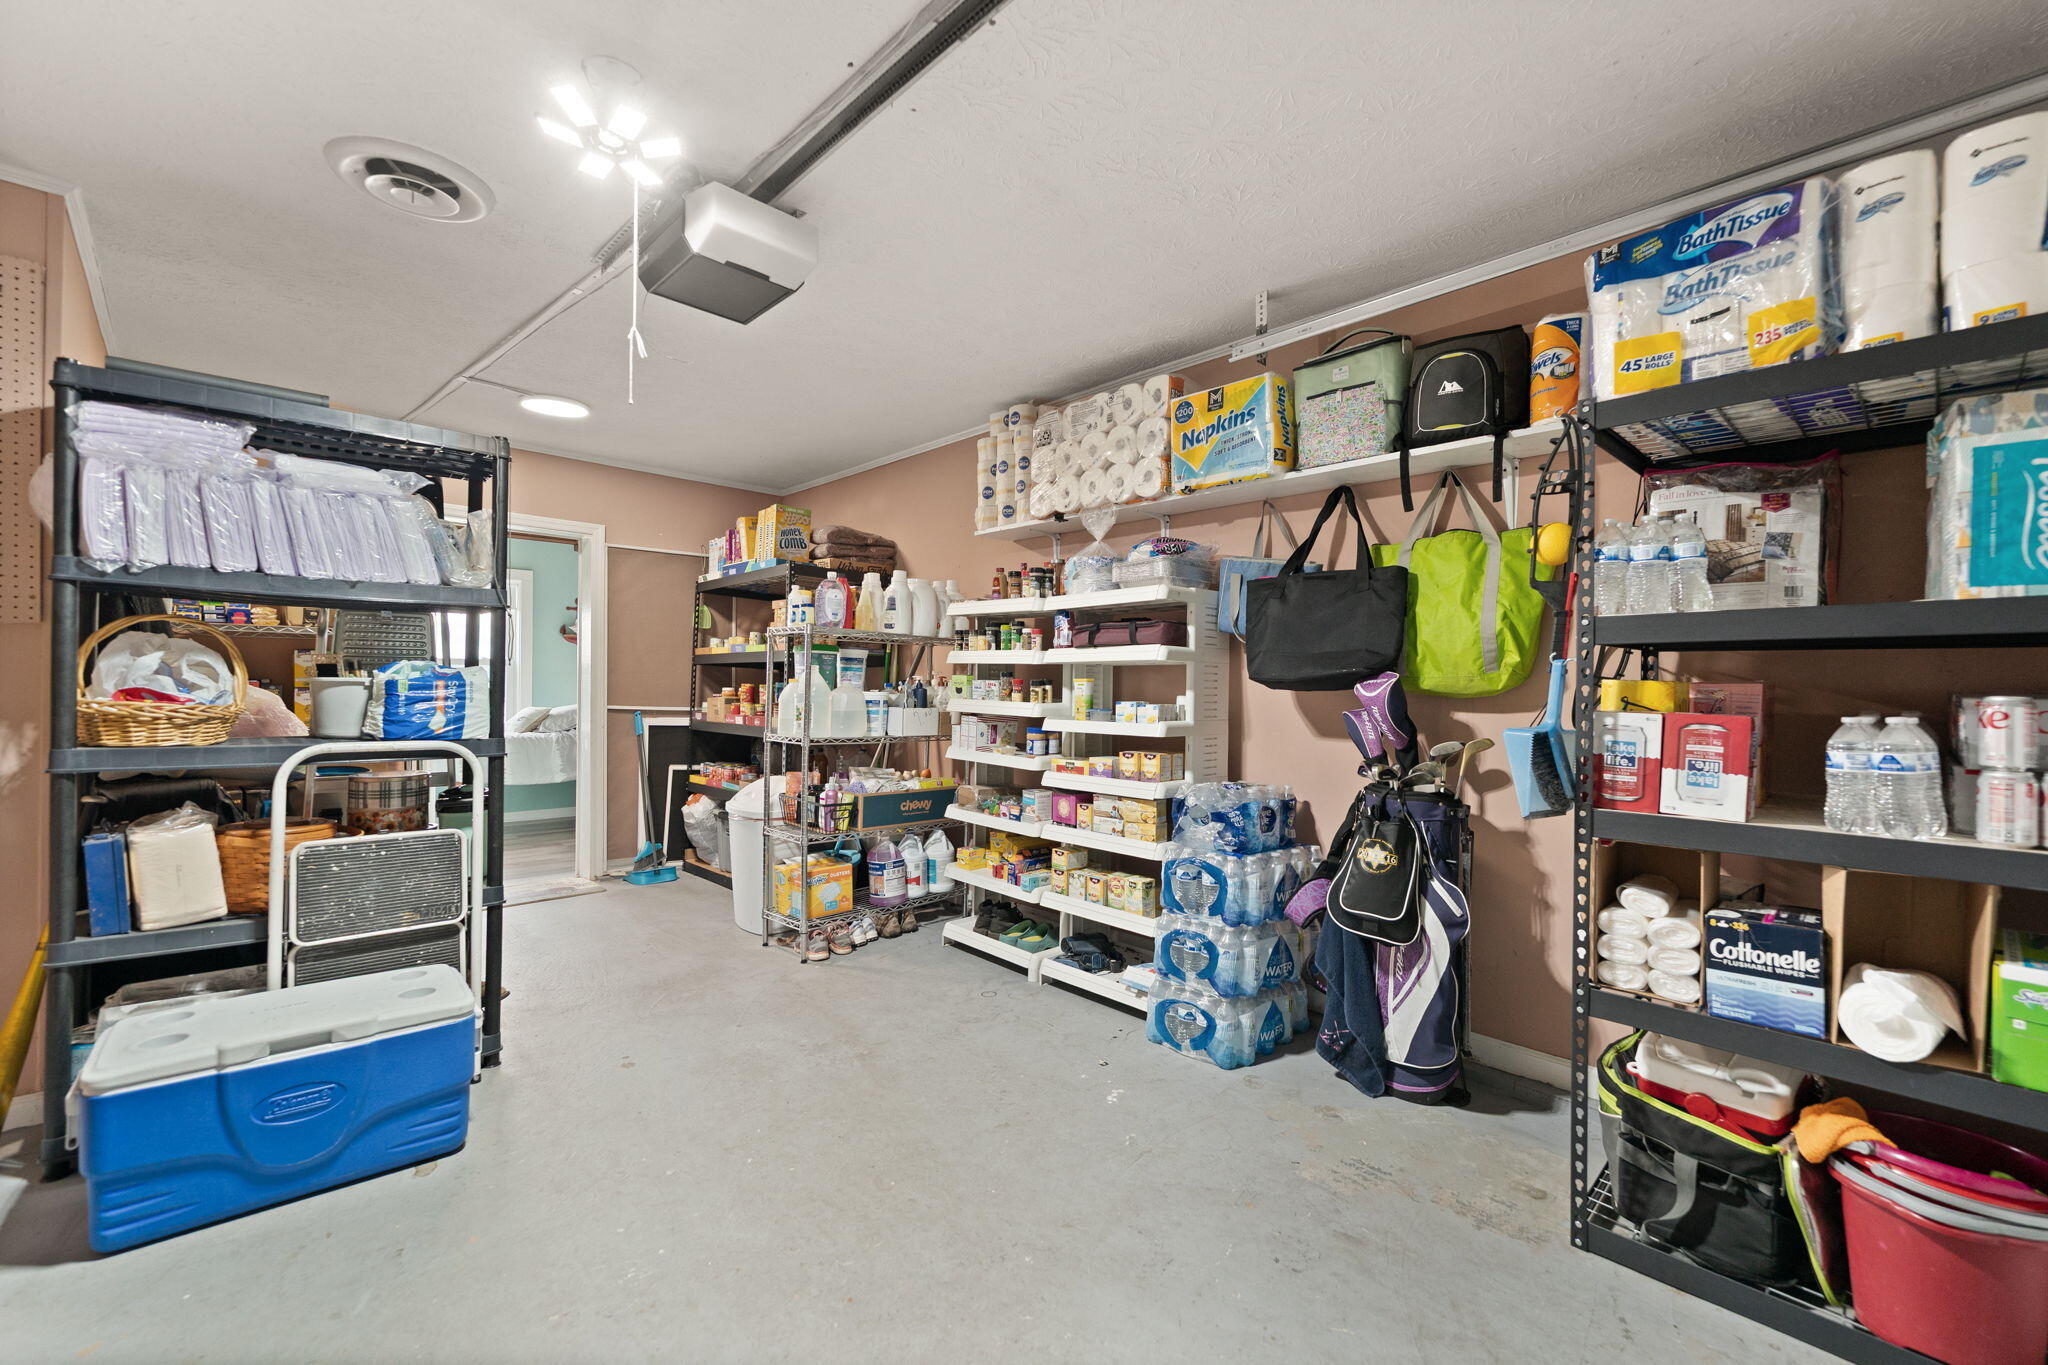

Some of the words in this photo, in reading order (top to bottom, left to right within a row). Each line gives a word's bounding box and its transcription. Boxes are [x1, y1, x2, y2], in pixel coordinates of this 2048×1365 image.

[1755, 327, 1783, 345] 235
[1620, 358, 1643, 373] 45
[1645, 352, 1674, 364] LARGE
[1276, 385, 1292, 447] Napkins
[1181, 406, 1257, 452] Napkins
[1658, 492, 1675, 501] Fall
[1607, 741, 1636, 753] lake
[1688, 775, 1719, 788] lake
[901, 800, 932, 811] chewy
[1386, 855, 1396, 864] 16
[1709, 938, 1820, 974] Cottonelle
[1265, 961, 1292, 977] WATER
[1723, 960, 1774, 973] FLUSHABLE
[1775, 966, 1806, 978] WIPES
